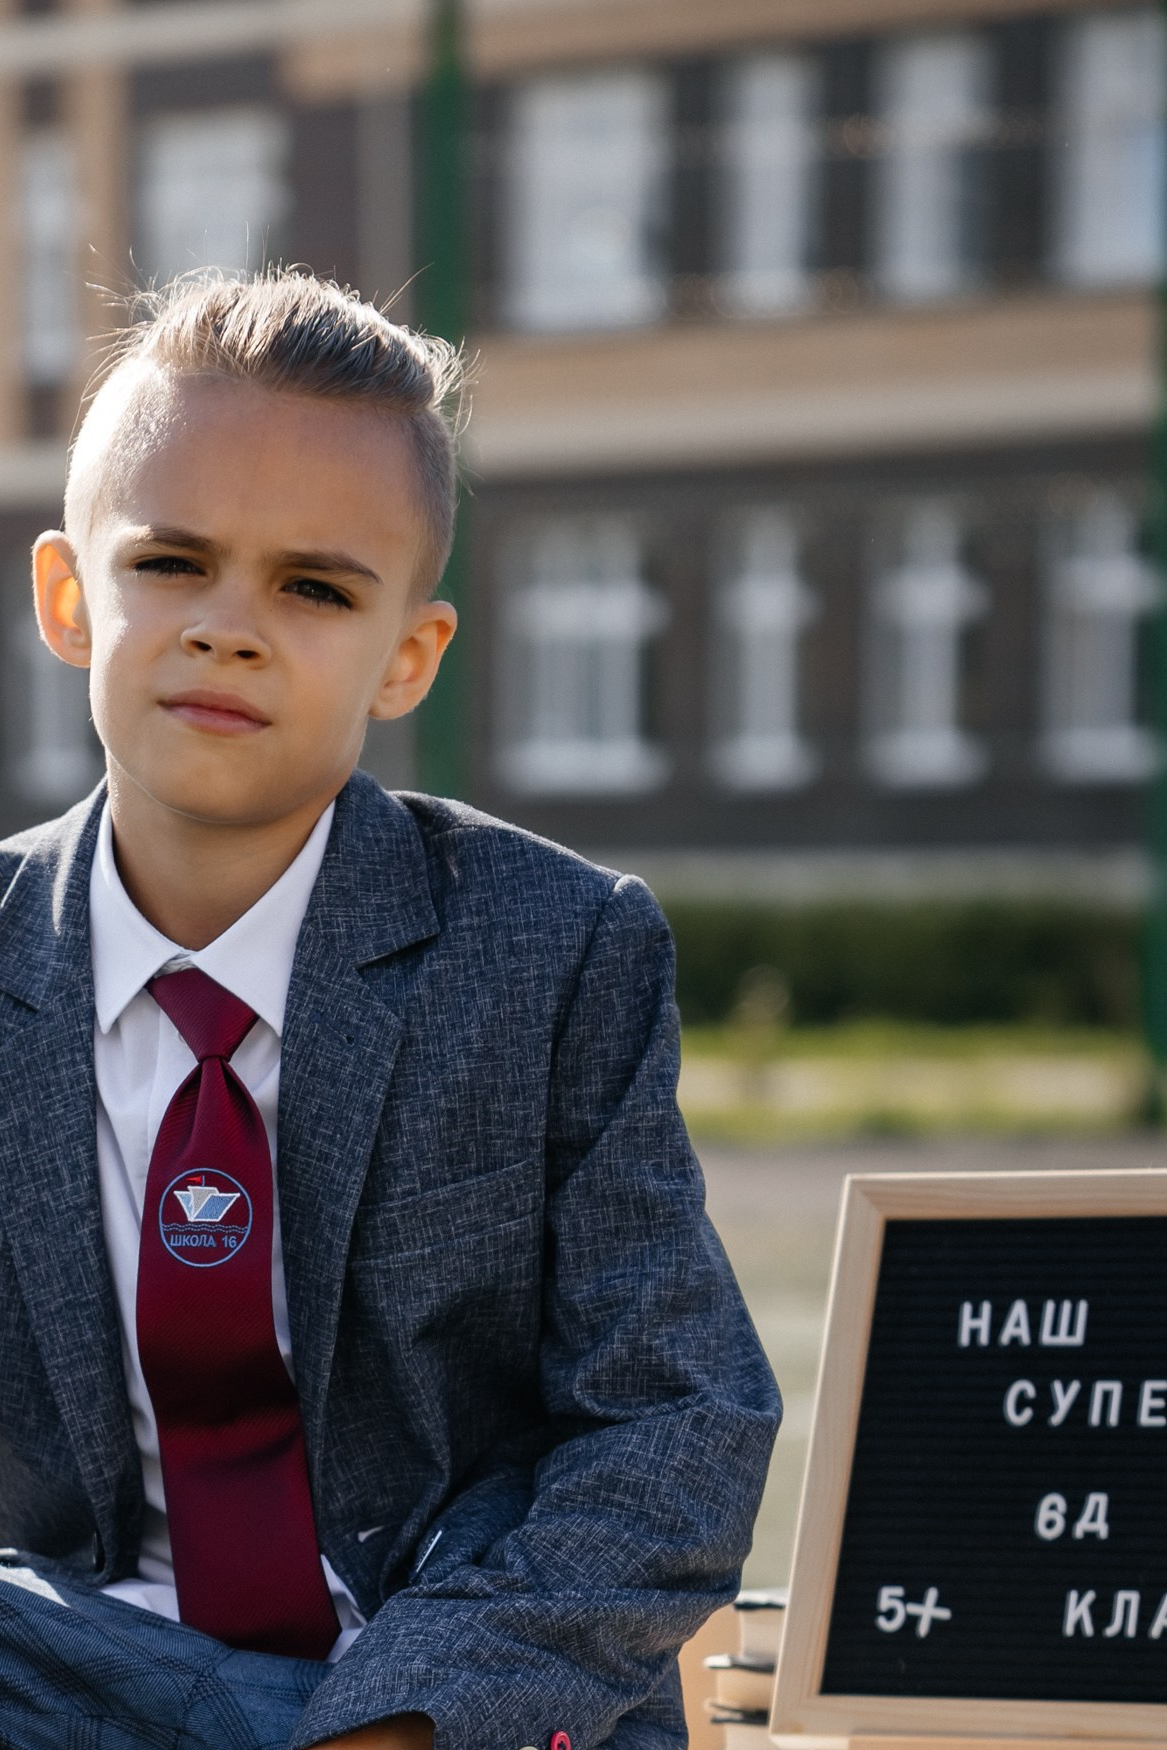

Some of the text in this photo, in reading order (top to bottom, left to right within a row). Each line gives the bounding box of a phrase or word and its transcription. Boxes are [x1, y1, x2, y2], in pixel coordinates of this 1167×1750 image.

[169, 1234, 237, 1248] ШКОЛА 16
[958, 1299, 1088, 1347] НАШ
[1004, 1379, 1167, 1427] СУПЕ
[1036, 1492, 1109, 1541] 6Д
[876, 1586, 952, 1638] 5+
